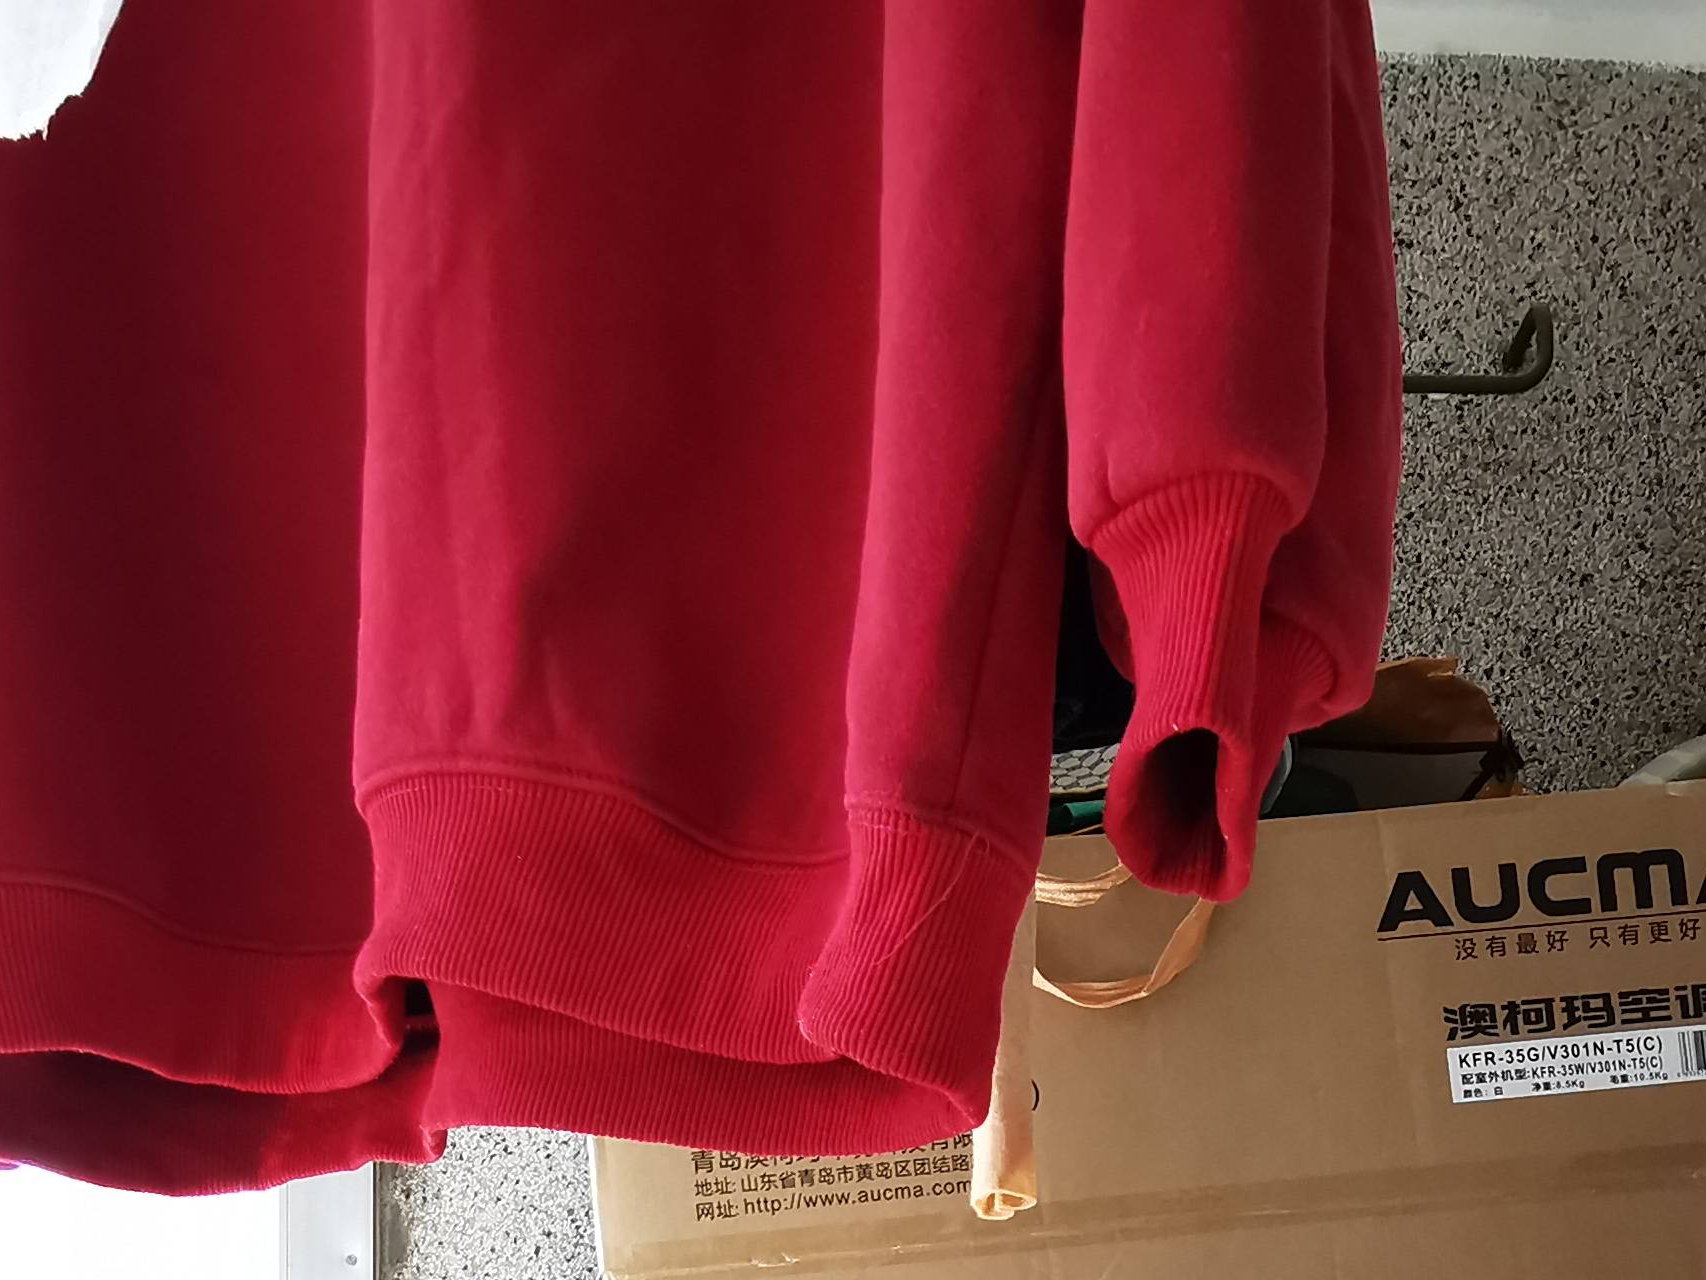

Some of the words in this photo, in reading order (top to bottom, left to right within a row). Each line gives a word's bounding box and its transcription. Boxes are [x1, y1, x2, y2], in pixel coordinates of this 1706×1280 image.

[1455, 930, 1569, 961] 没有最好
[1589, 918, 1702, 949] 只有更好
[1458, 1036, 1664, 1069] KFR-35G/V301N-T5(C)
